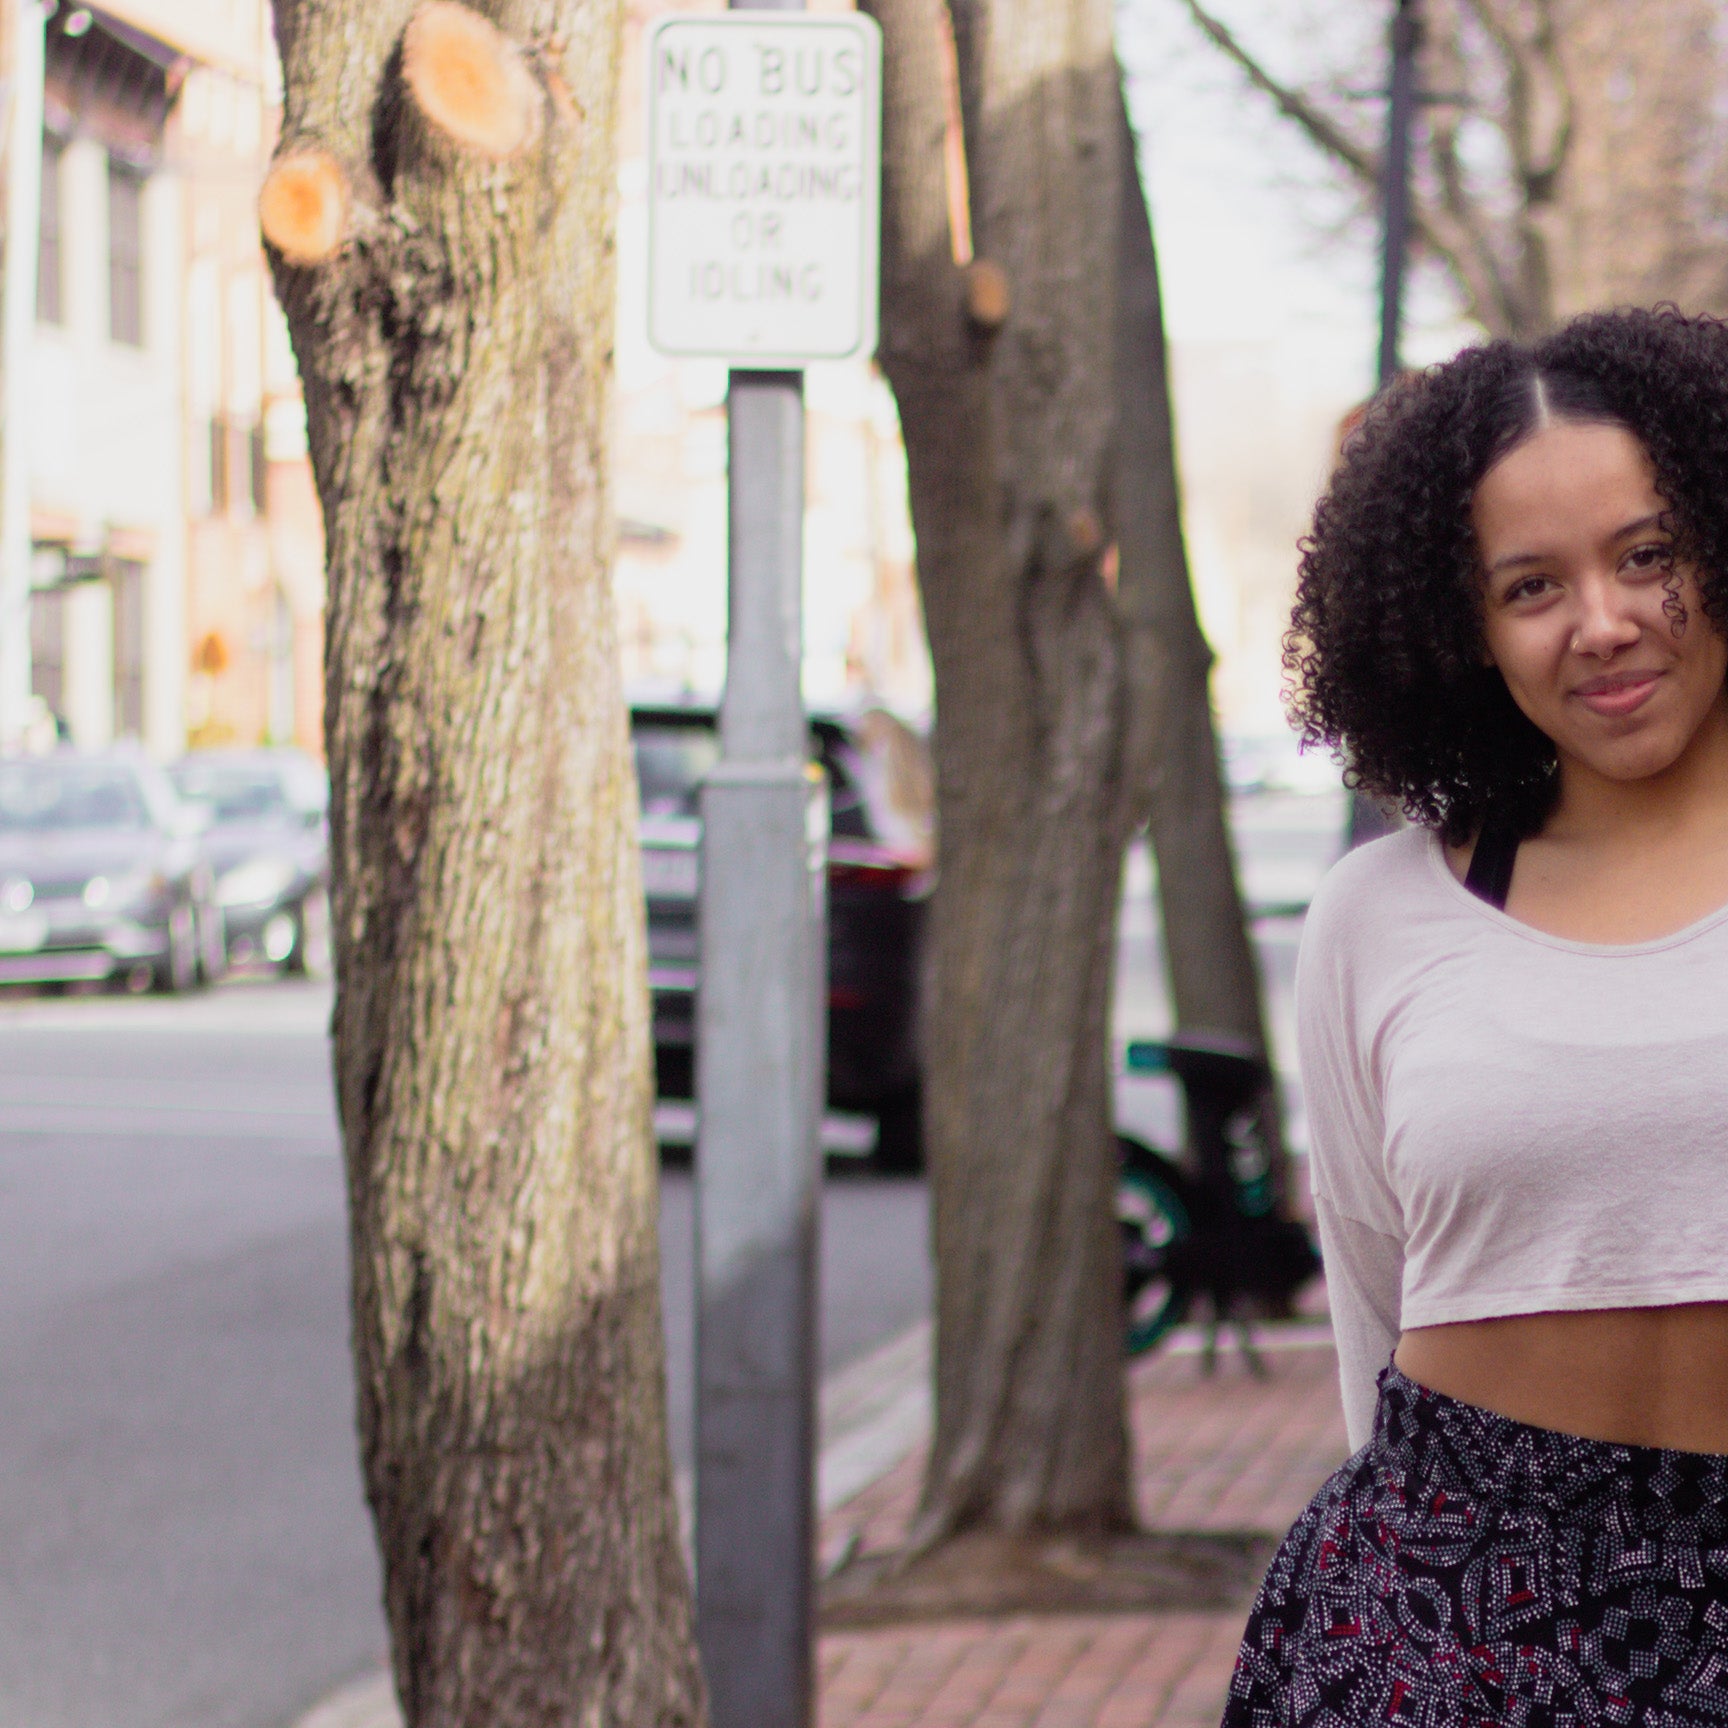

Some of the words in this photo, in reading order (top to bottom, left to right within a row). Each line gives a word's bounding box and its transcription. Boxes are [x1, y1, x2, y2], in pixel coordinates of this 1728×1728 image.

[659, 45, 727, 96] NO
[759, 45, 861, 98] BUS
[668, 109, 850, 152] LOADING
[657, 160, 862, 202] UNLOADING
[731, 210, 785, 252] OR
[688, 260, 825, 304] IDLING
